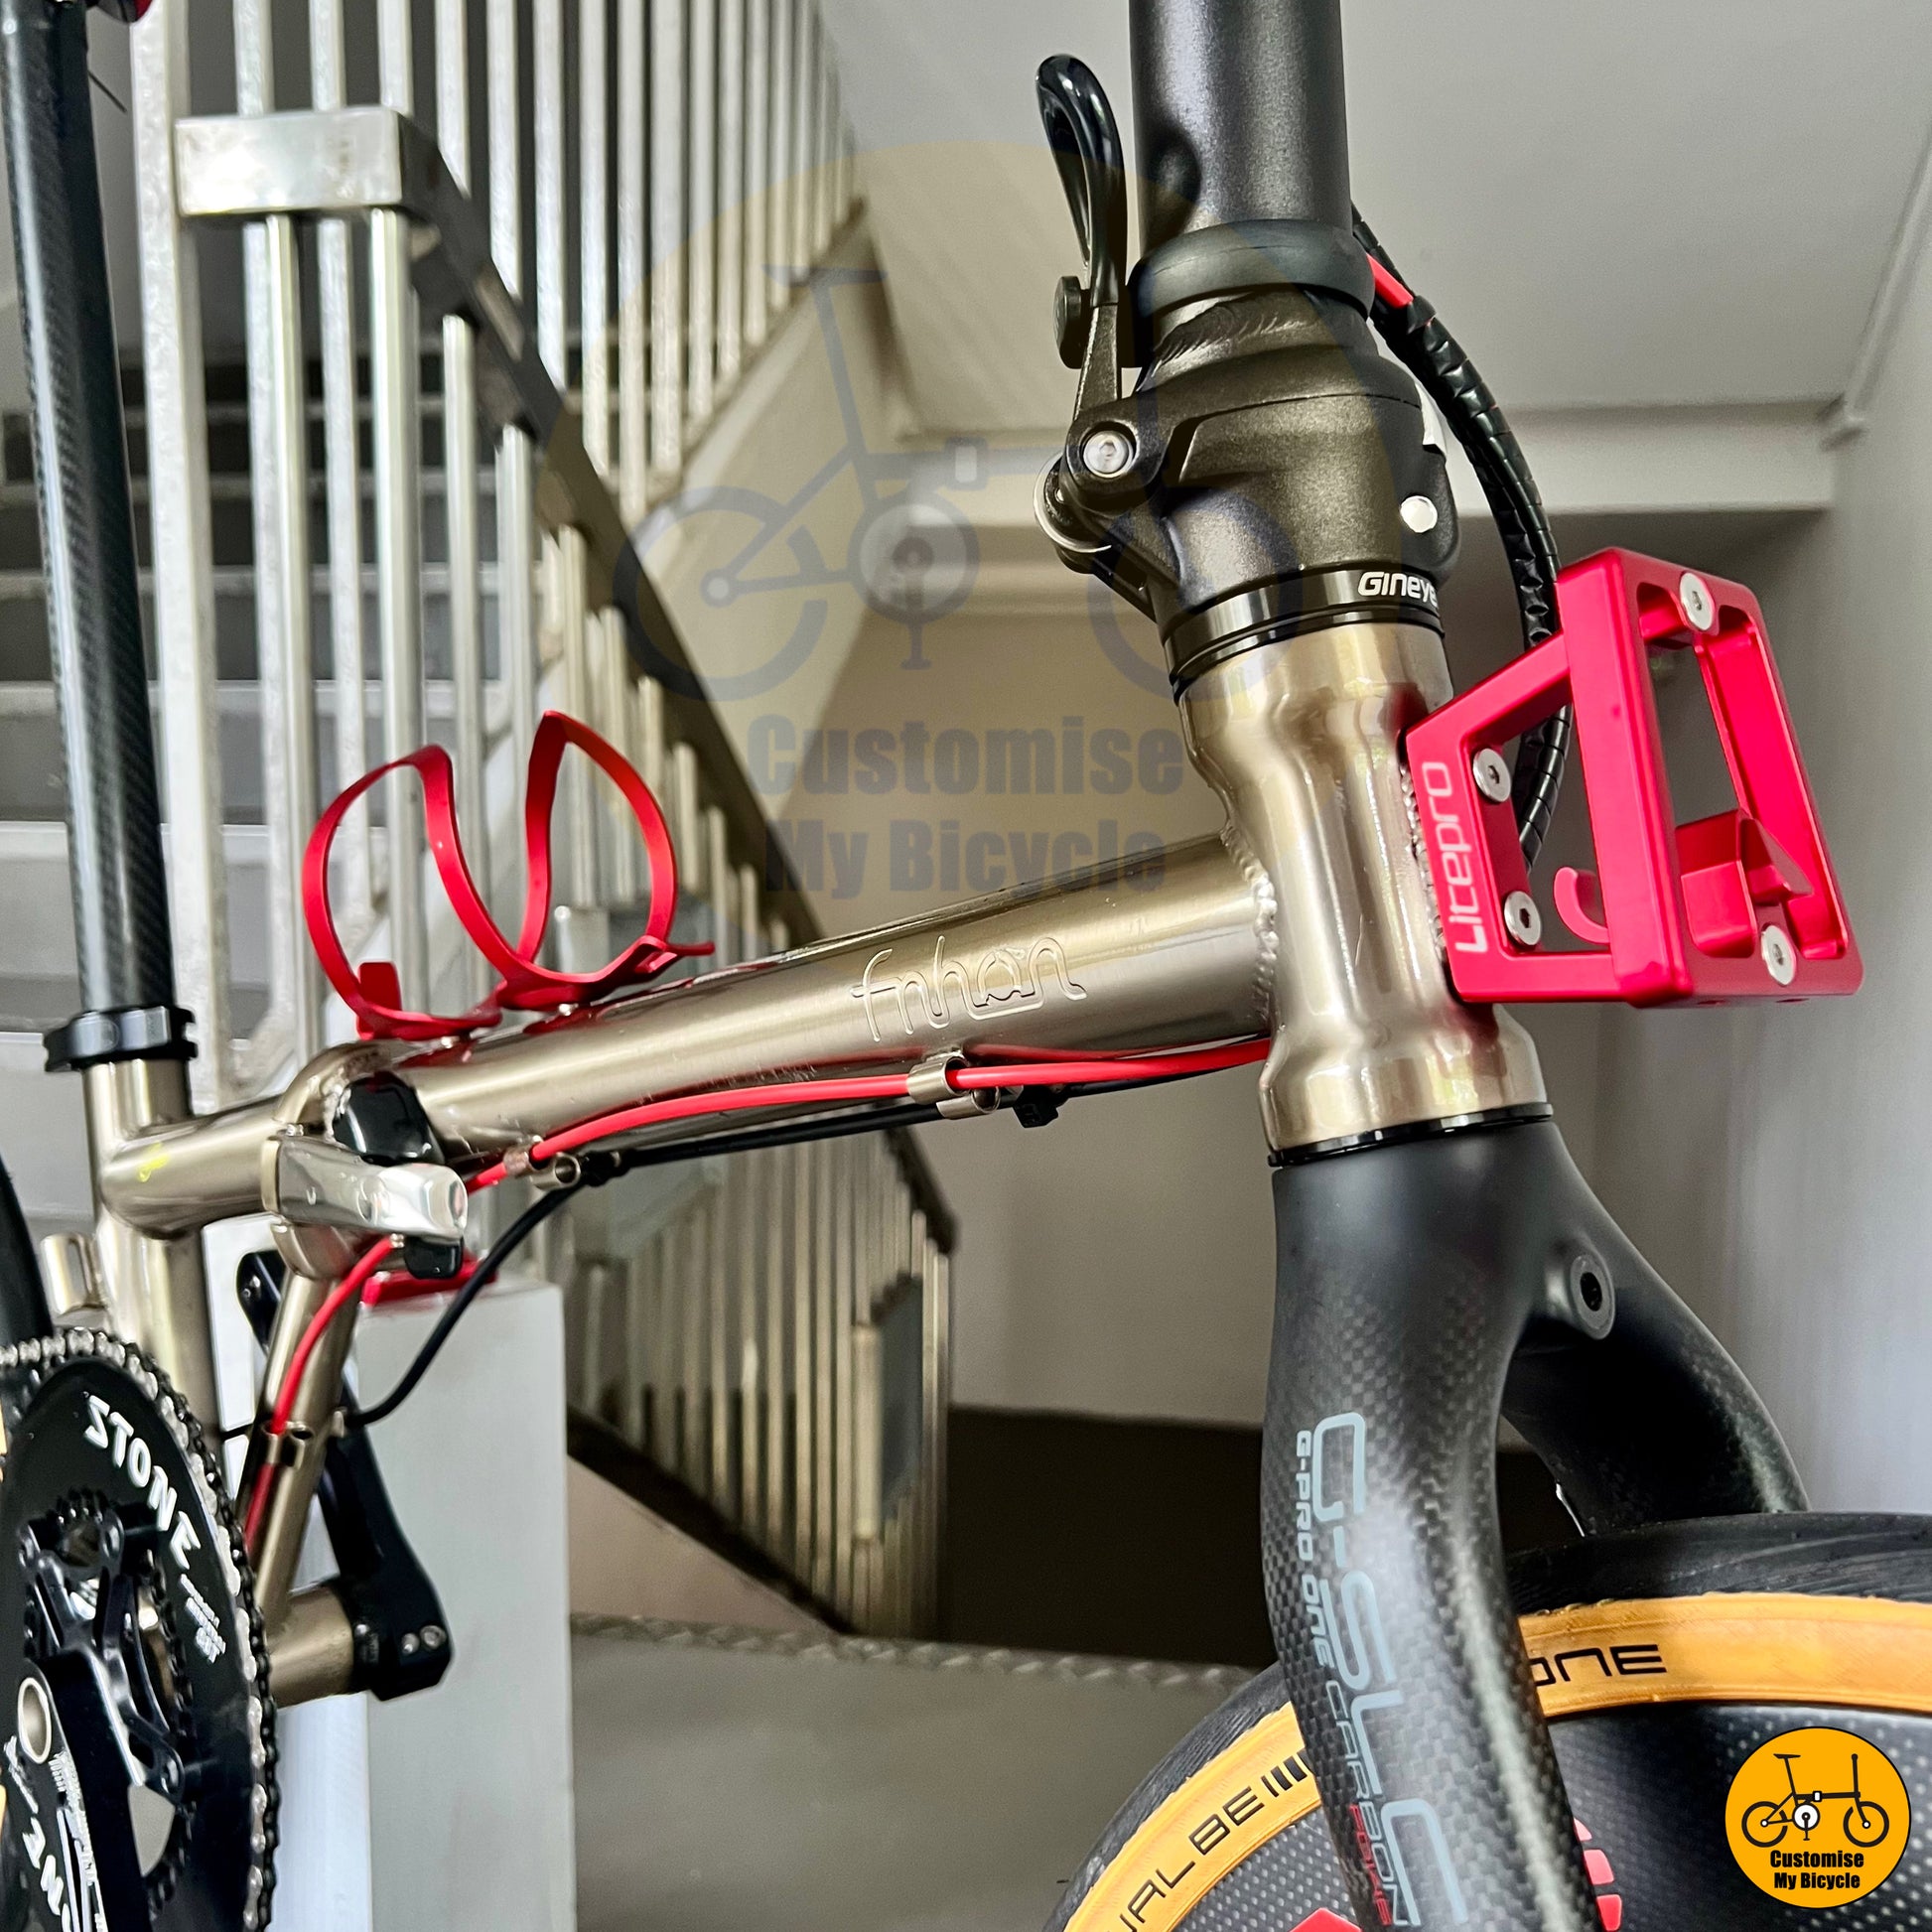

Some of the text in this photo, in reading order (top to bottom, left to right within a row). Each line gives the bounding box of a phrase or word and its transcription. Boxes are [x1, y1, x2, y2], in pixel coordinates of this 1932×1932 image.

[84, 1394, 202, 1571] STONE
[1296, 1430, 1313, 1562] G-PRO
[1326, 1680, 1409, 1927] CARBON
